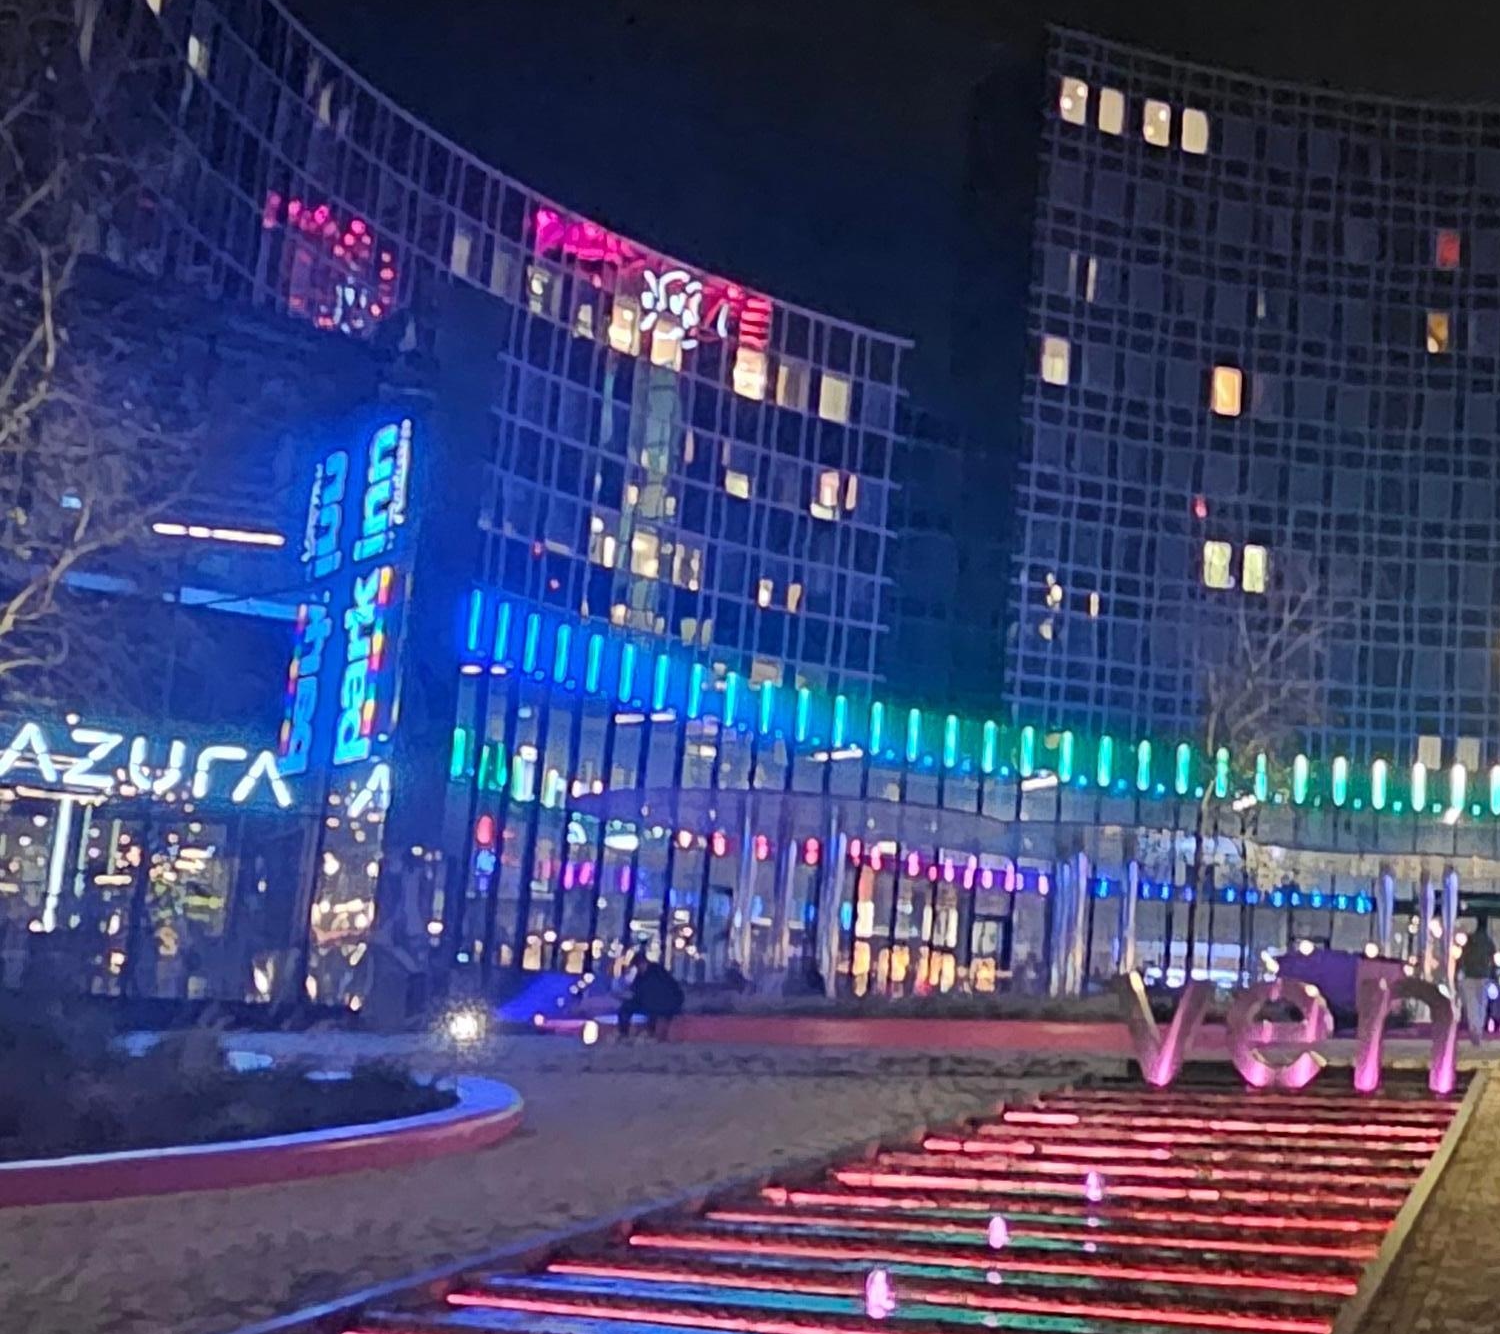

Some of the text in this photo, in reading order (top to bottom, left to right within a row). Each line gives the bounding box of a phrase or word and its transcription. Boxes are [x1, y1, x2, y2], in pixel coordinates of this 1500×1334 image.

[333, 424, 399, 765] park inn
[1118, 971, 1459, 1093] ven
